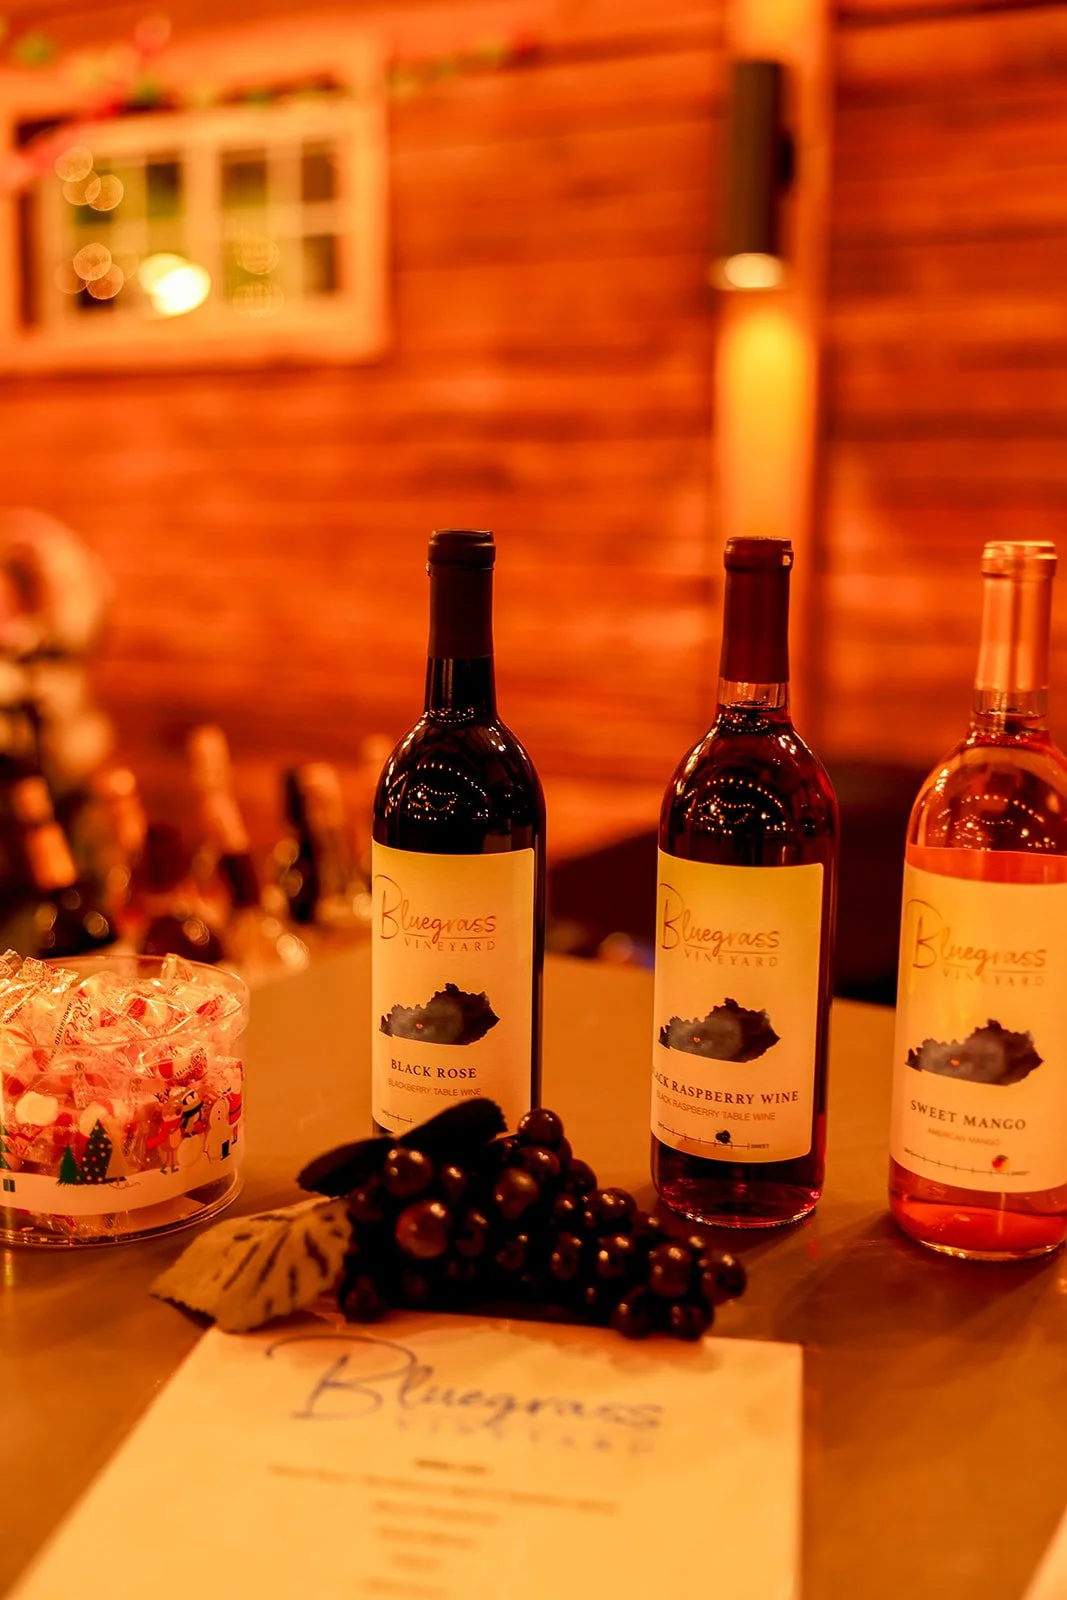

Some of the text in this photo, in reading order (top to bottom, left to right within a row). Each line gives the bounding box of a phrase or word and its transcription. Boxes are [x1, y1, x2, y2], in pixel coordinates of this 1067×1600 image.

[375, 874, 497, 944] Bluegrass
[659, 883, 780, 957] Bluegrass
[404, 937, 496, 952] VINEYARD
[905, 899, 1047, 976] Bluegrass
[685, 949, 779, 967] VINEYARD
[943, 968, 1046, 986] VINEYARD
[391, 1058, 478, 1079] BLACK ROSE
[388, 1078, 481, 1097] BLACKBERRY TABLE WINE
[671, 1080, 755, 1105] RASPBERRY
[760, 1090, 799, 1105] WINE
[672, 1099, 720, 1118] RASPBERRY
[722, 1111, 750, 1122] TABLE
[753, 1112, 776, 1122] WINE
[910, 1099, 1027, 1130] SWEET MANGO
[264, 1334, 665, 1430] Bluegrass
